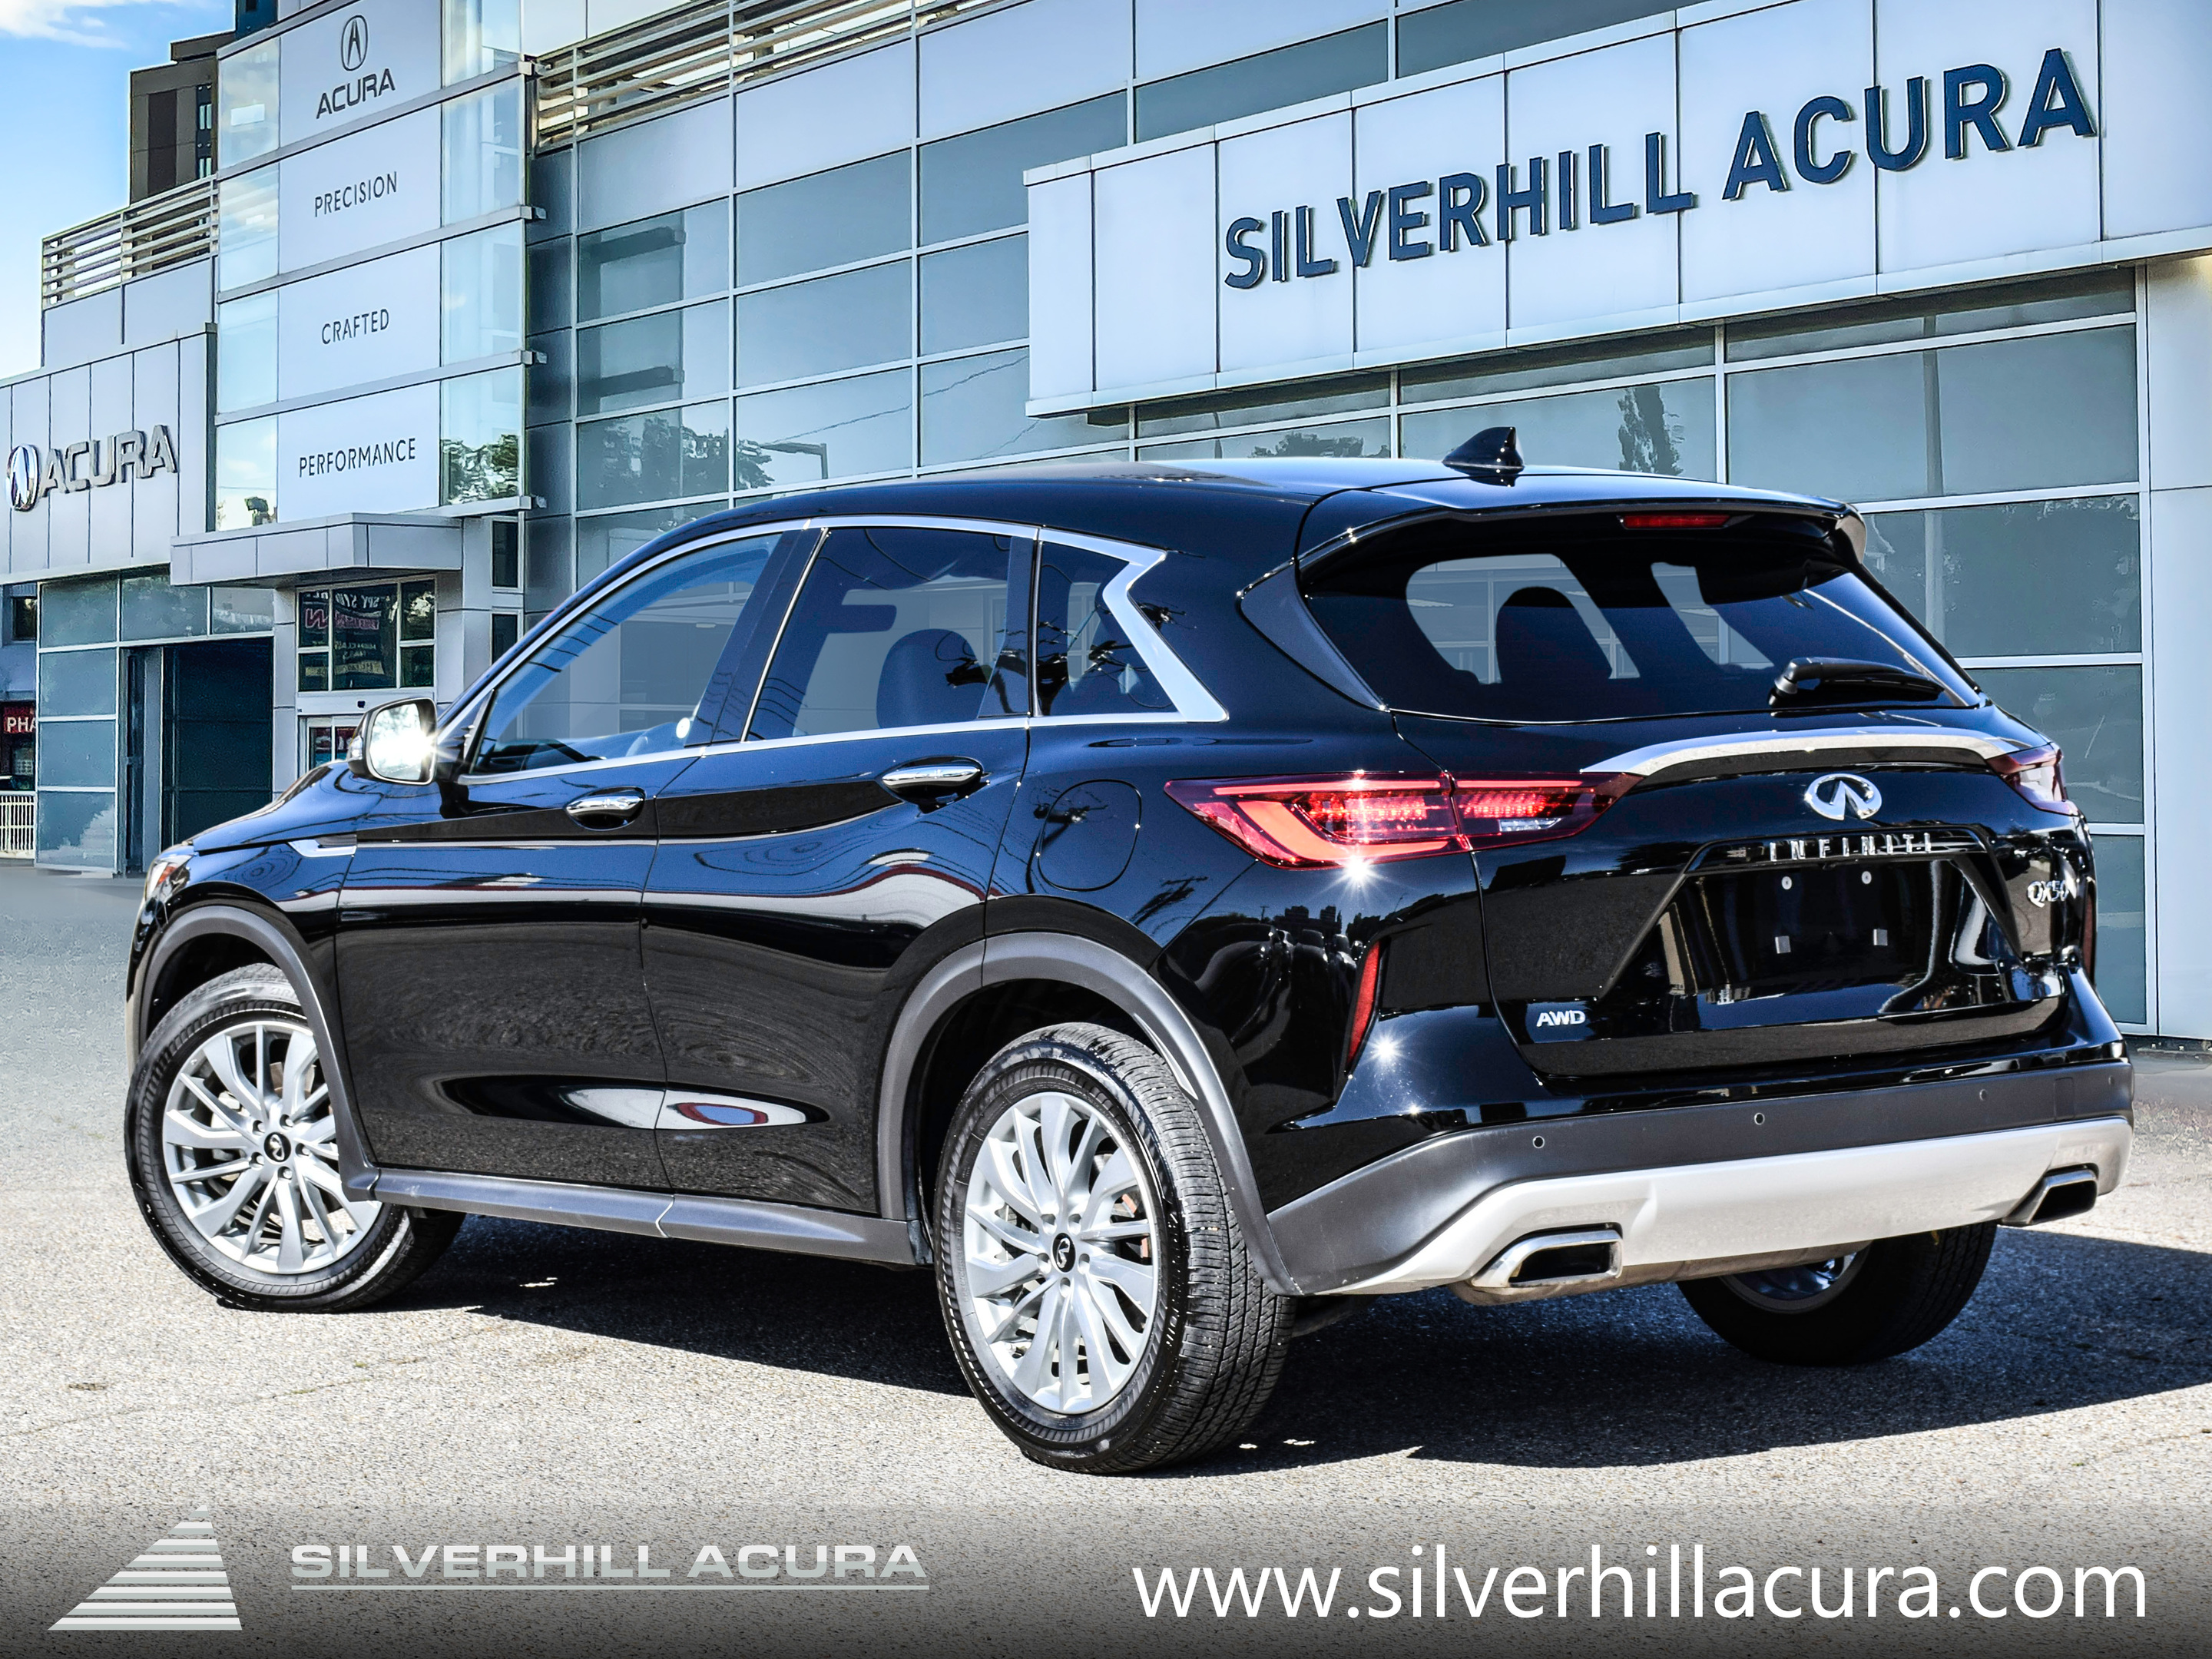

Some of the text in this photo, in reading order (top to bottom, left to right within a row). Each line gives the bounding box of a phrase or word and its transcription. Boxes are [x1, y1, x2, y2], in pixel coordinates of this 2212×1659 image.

[316, 68, 396, 121] ACURA
[1224, 48, 2098, 290] SILVERHILL ACURA
[314, 171, 398, 218] PRECISION
[321, 308, 390, 346] CRAFTED
[38, 424, 178, 495] ACURA
[299, 437, 417, 478] PERFORMANCE
[1770, 833, 1932, 862] INFINITI
[1536, 1010, 1586, 1028] AWD
